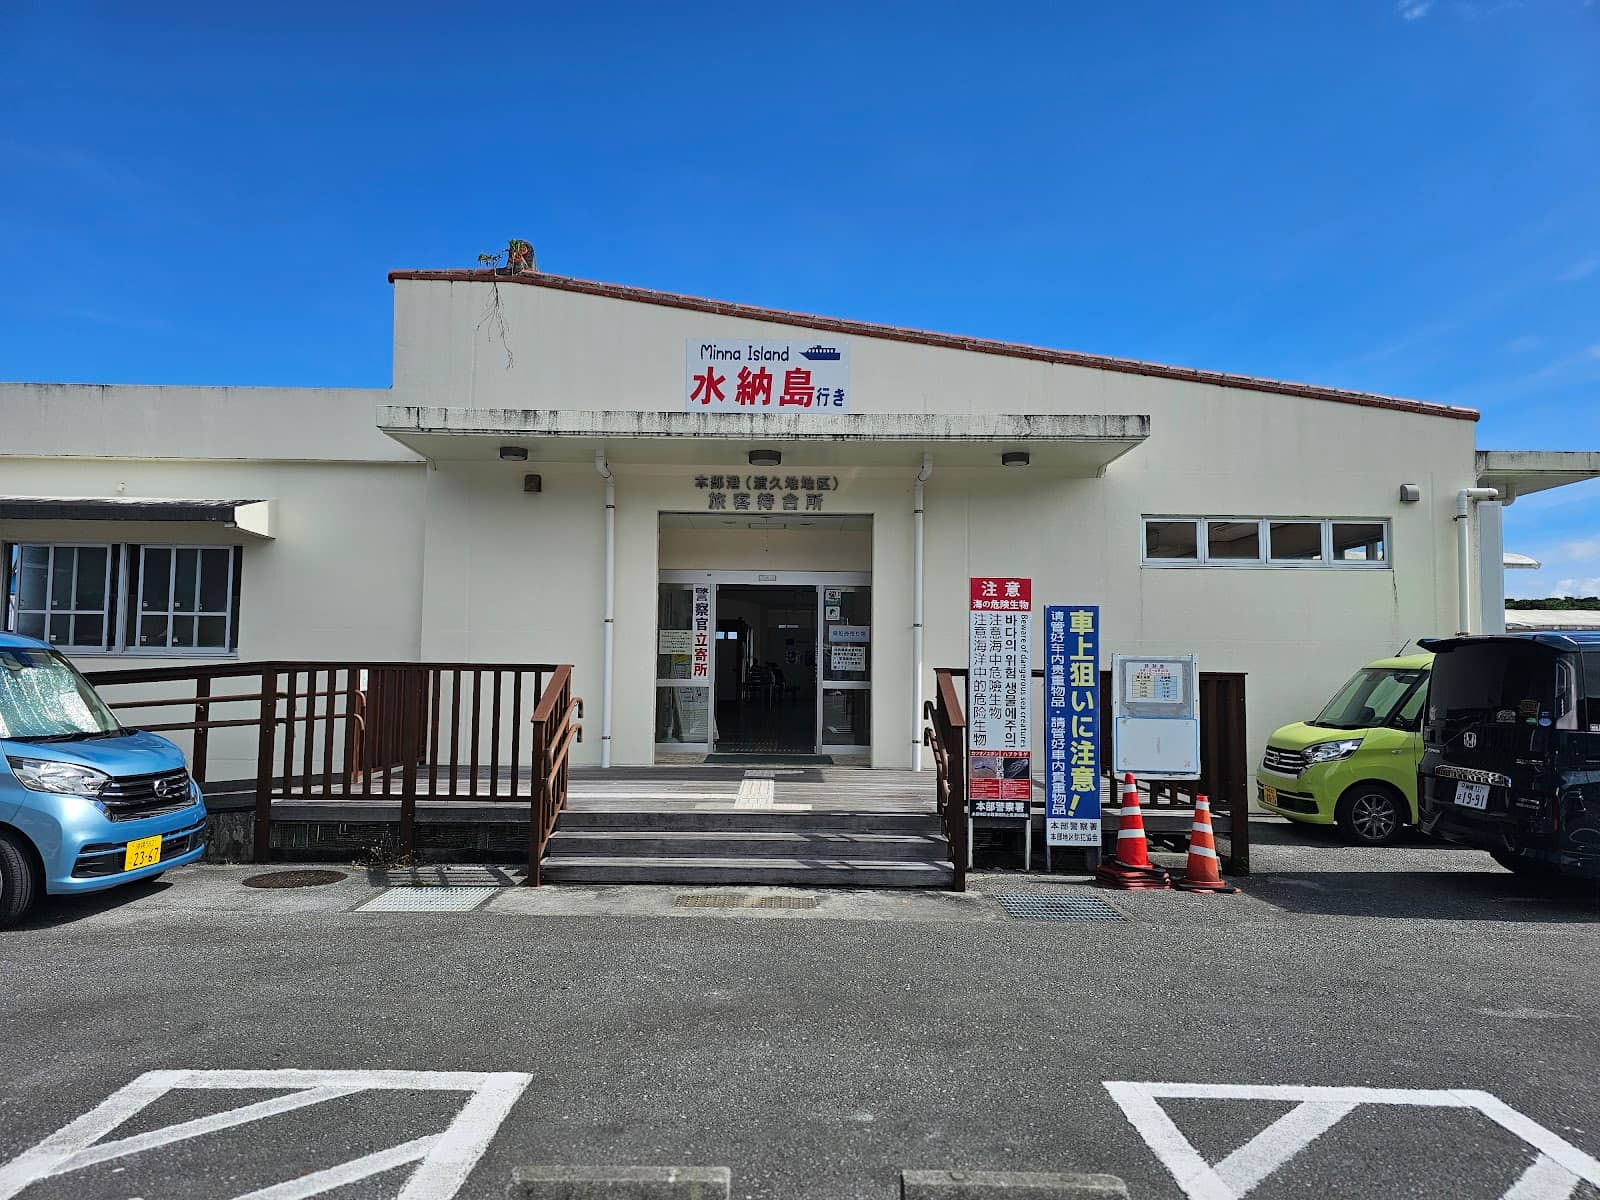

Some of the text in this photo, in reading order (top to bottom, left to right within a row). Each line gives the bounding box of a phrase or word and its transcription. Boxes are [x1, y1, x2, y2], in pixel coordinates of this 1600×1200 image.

[701, 345, 789, 361] Minna Island
[981, 581, 1020, 597] 注意
[972, 599, 1029, 610] 海の危険生物
[694, 587, 709, 677] 警察官立寄所
[1020, 615, 1028, 643] Beware
[1020, 645, 1028, 654] of
[1019, 654, 1028, 695] dangerous
